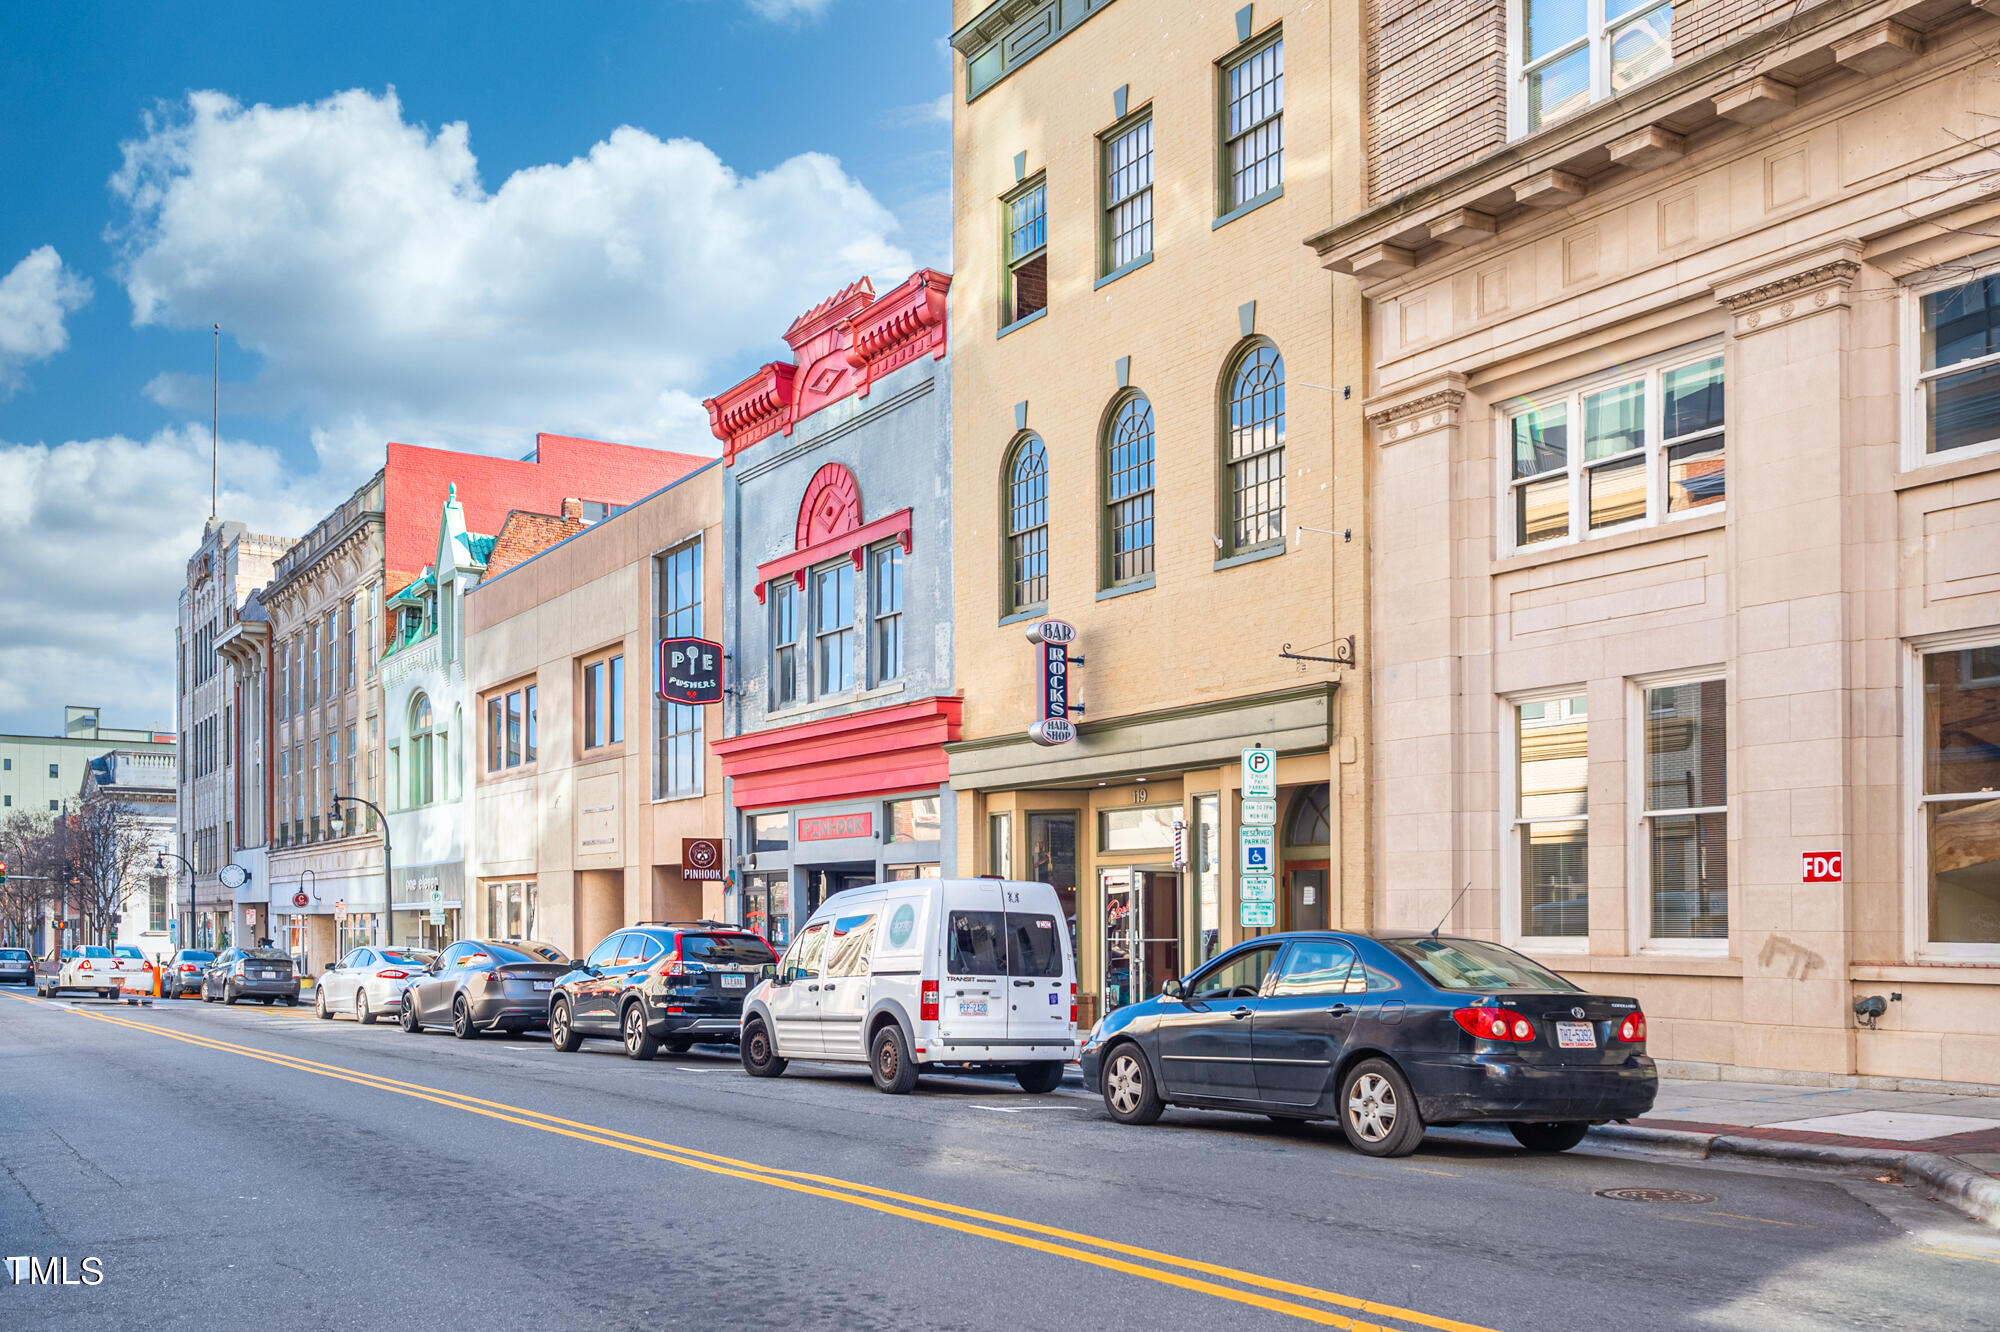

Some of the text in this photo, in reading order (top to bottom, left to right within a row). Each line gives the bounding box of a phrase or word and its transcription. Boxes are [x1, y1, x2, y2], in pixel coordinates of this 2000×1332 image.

[1044, 623, 1072, 640] BAR
[669, 676, 716, 689] PUSHERS
[1049, 647, 1066, 716] ROCKS
[1047, 721, 1069, 731] HAIR
[1046, 730, 1071, 741] SHOP
[1254, 756, 1265, 769] P
[802, 817, 865, 838] PINHOOK
[1242, 829, 1272, 837] RESERVED
[1803, 856, 1841, 878] FDC
[684, 868, 722, 880] PINHOOK
[1559, 1028, 1593, 1042] THZ-5392
